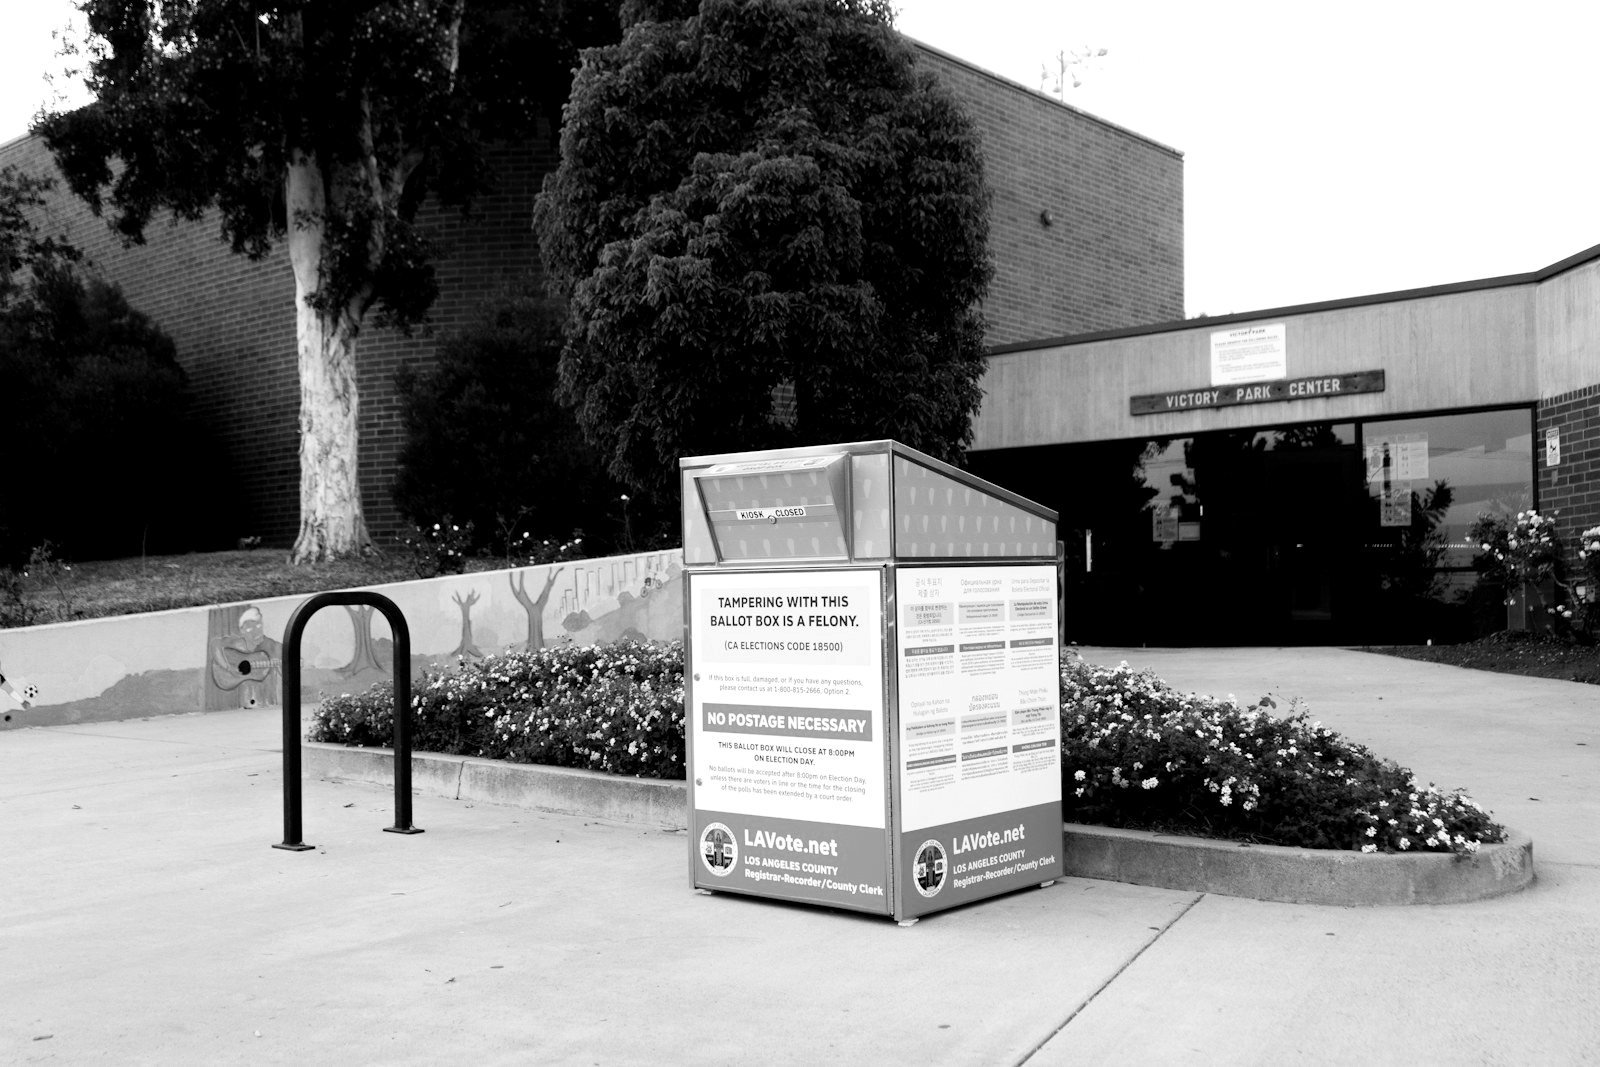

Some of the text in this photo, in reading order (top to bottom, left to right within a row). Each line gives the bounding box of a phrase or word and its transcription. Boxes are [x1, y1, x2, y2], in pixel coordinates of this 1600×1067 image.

[1166, 379, 1340, 408] VICTORY PARK CENTER
[775, 508, 804, 517] CLOSED
[718, 596, 848, 608] TAMPERING WITH THIS
[711, 615, 858, 627] BALLOT BOX IS A FELONY.
[724, 640, 843, 652] (CA ELECTIONS CODE 18500)
[708, 712, 866, 733] NO POSTAGE NECESSARY
[766, 756, 798, 764] ELECTION
[828, 749, 854, 757] 8:00PM
[756, 769, 780, 778] accepted
[797, 772, 818, 780] 8:00pm
[844, 786, 866, 795] closing
[744, 829, 838, 856] LAVote.net
[953, 824, 1025, 855] LAVote.net
[744, 856, 838, 876] LOS ANGELES COUNTY
[953, 849, 1025, 875] LOS ANGELES COUNTY
[954, 855, 1055, 889] Registrar-Recorder/County Clerk
[745, 869, 883, 896] Registrar-Recorder/County Clerk
